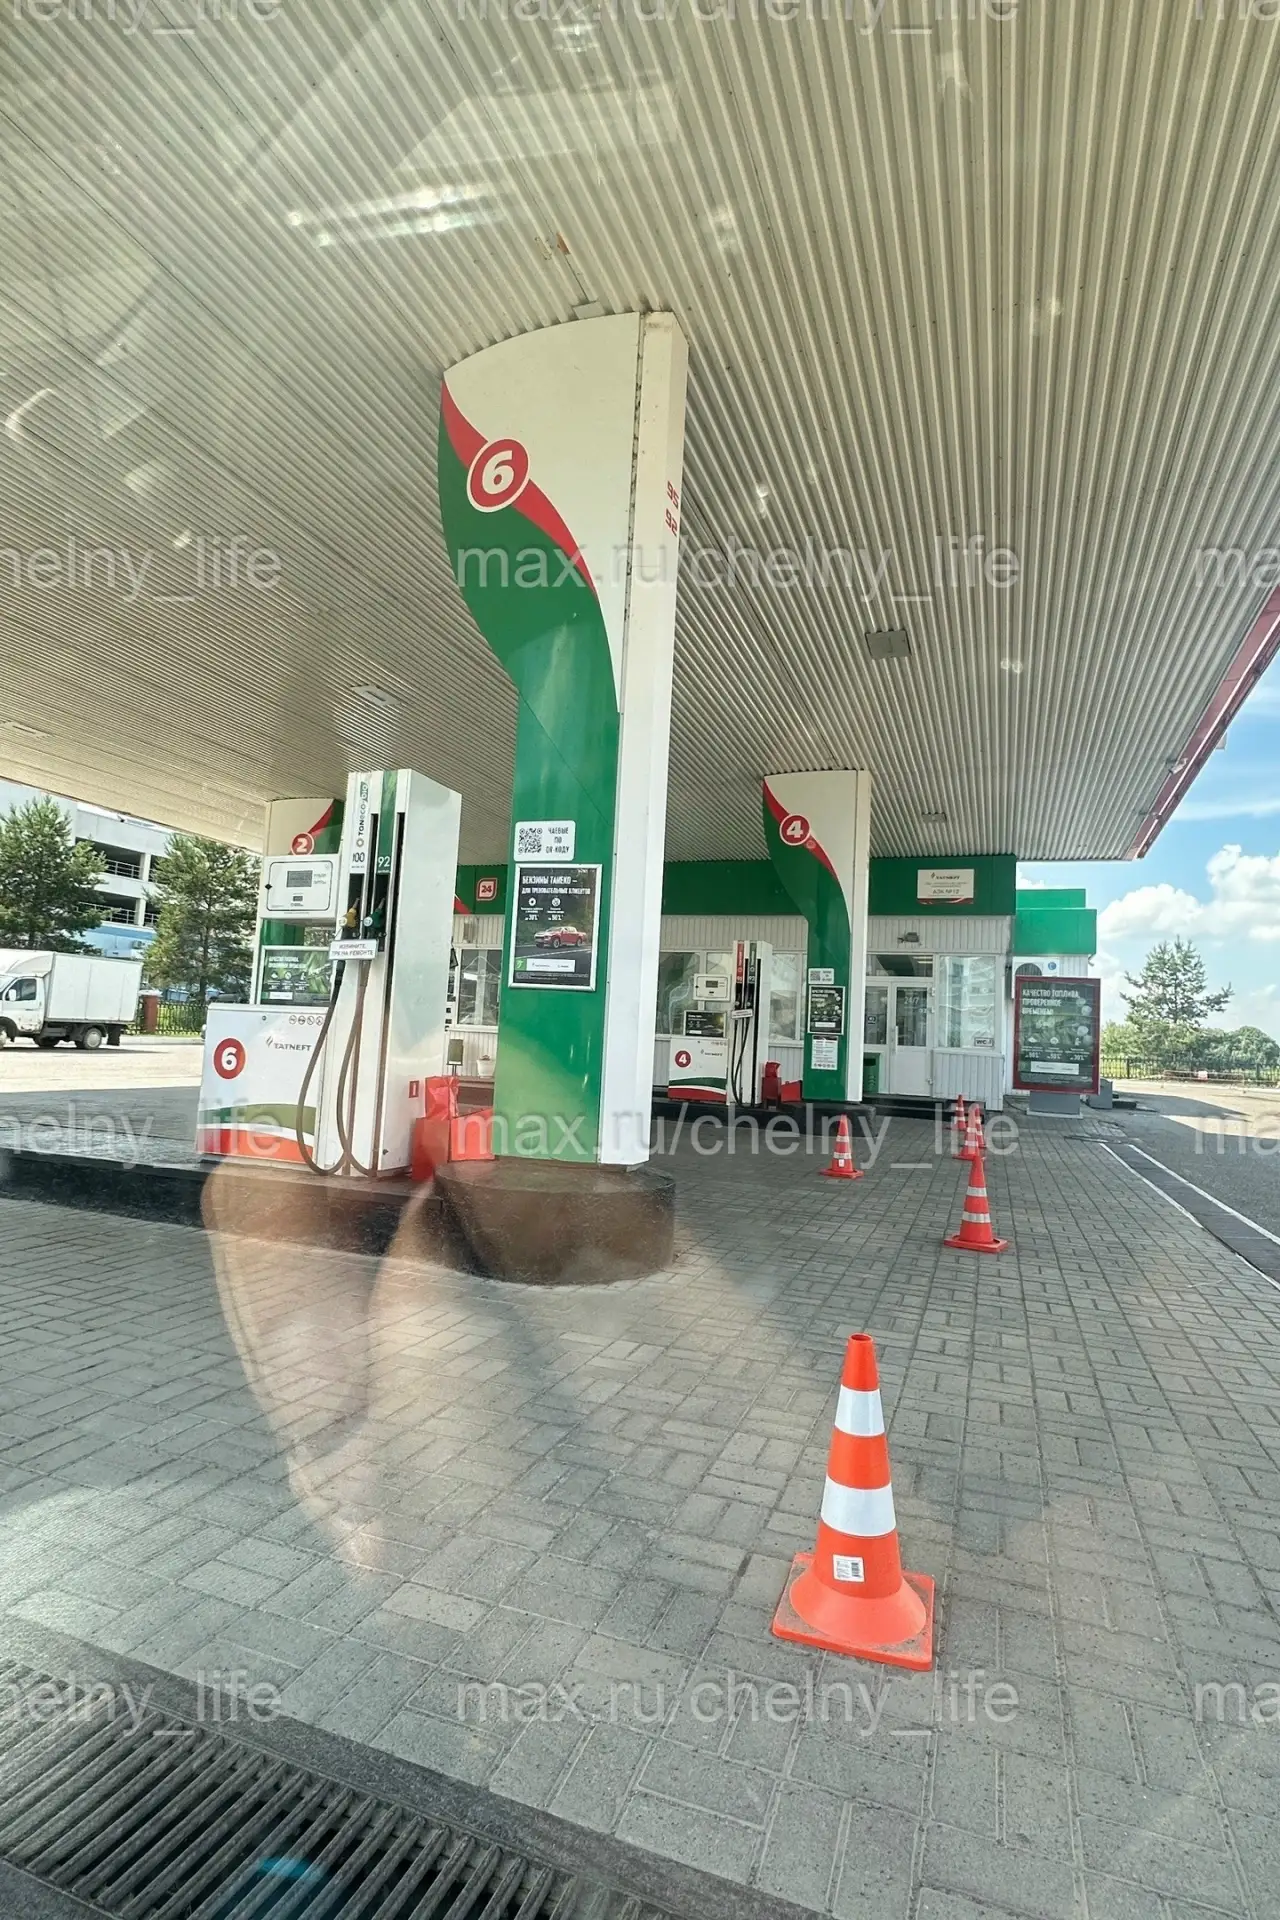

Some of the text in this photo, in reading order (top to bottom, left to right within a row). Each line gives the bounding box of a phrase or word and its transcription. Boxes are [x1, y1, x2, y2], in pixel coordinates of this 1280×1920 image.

[482, 450, 514, 495] 6
[667, 481, 679, 510] 95
[665, 508, 678, 537] 92
[786, 820, 804, 838] 4
[296, 838, 309, 853] 2
[352, 852, 366, 863] 100
[377, 856, 391, 867] 92
[481, 885, 492, 893] 24
[274, 1044, 313, 1052] TATNEFT
[221, 1046, 238, 1071] 6
[679, 1054, 688, 1065] 4
